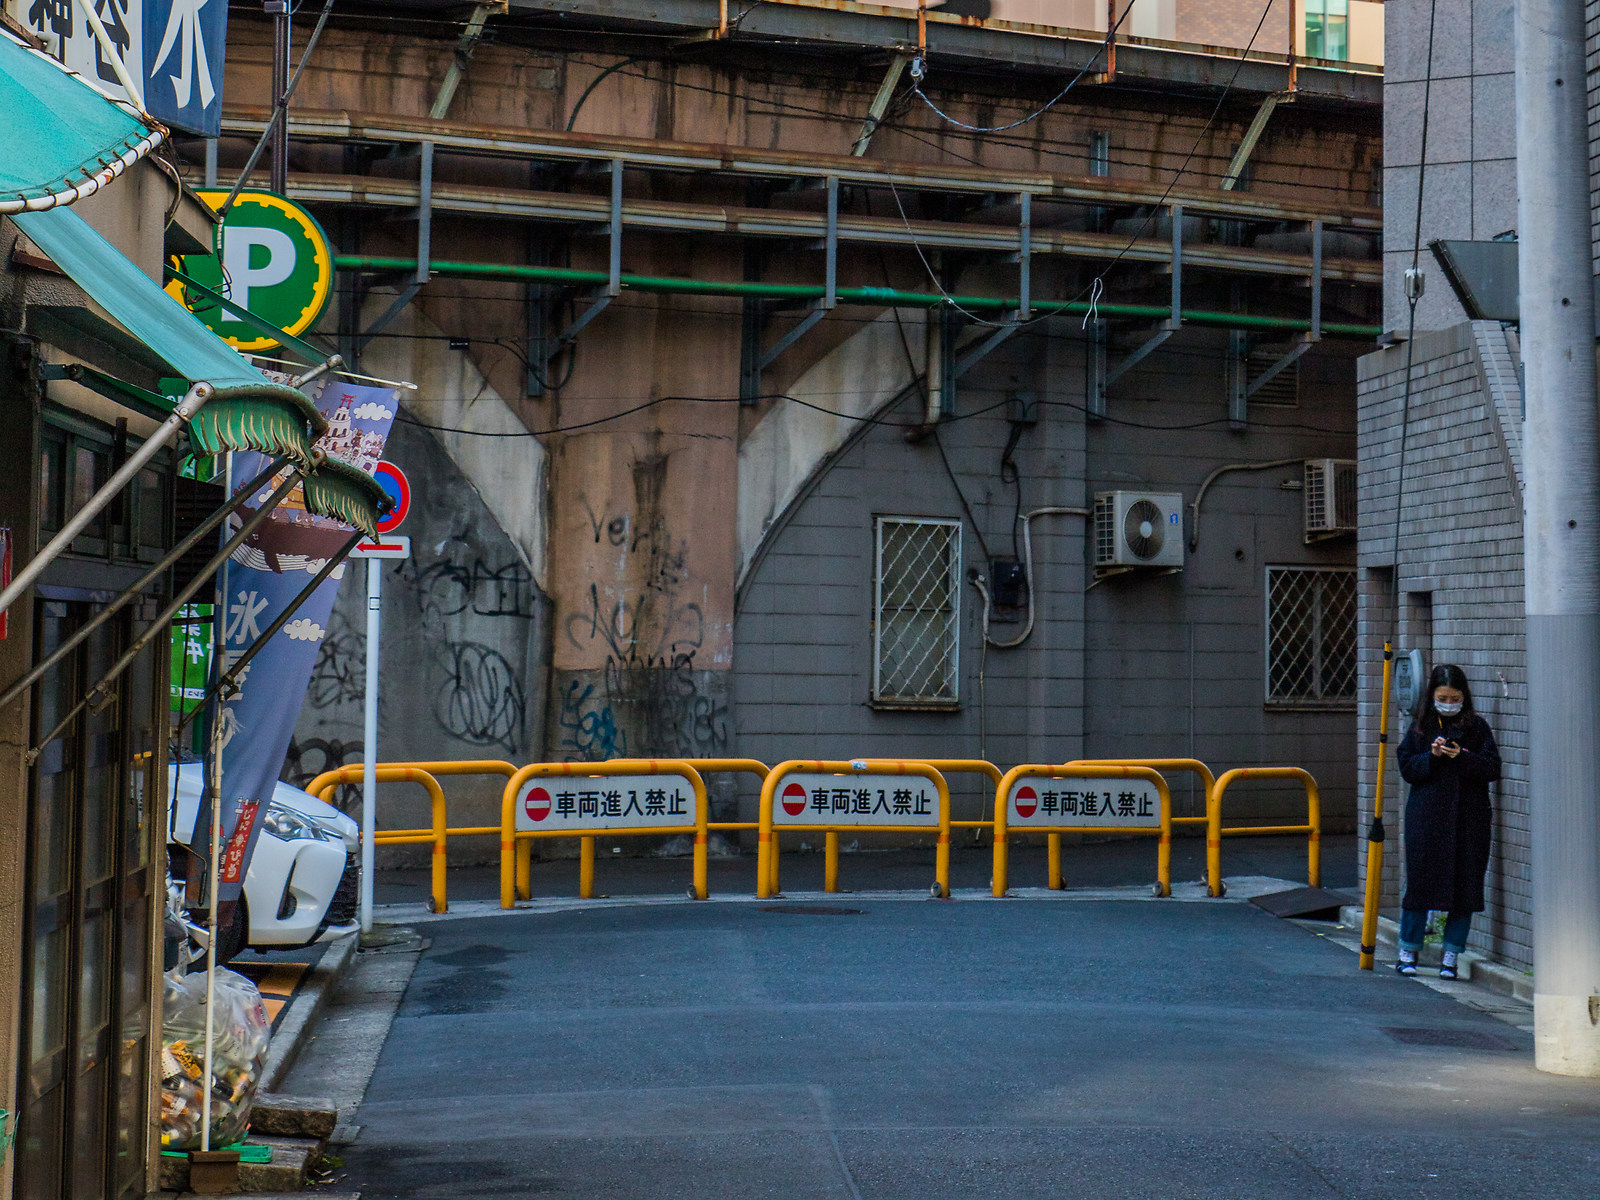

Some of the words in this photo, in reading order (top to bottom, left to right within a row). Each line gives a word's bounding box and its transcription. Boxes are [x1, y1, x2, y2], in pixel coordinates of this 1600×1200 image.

[221, 226, 297, 322] P
[555, 788, 687, 819] 車両進入禁止
[810, 787, 932, 815] 車両進入禁止
[1041, 790, 1154, 817] 車両進入禁止
